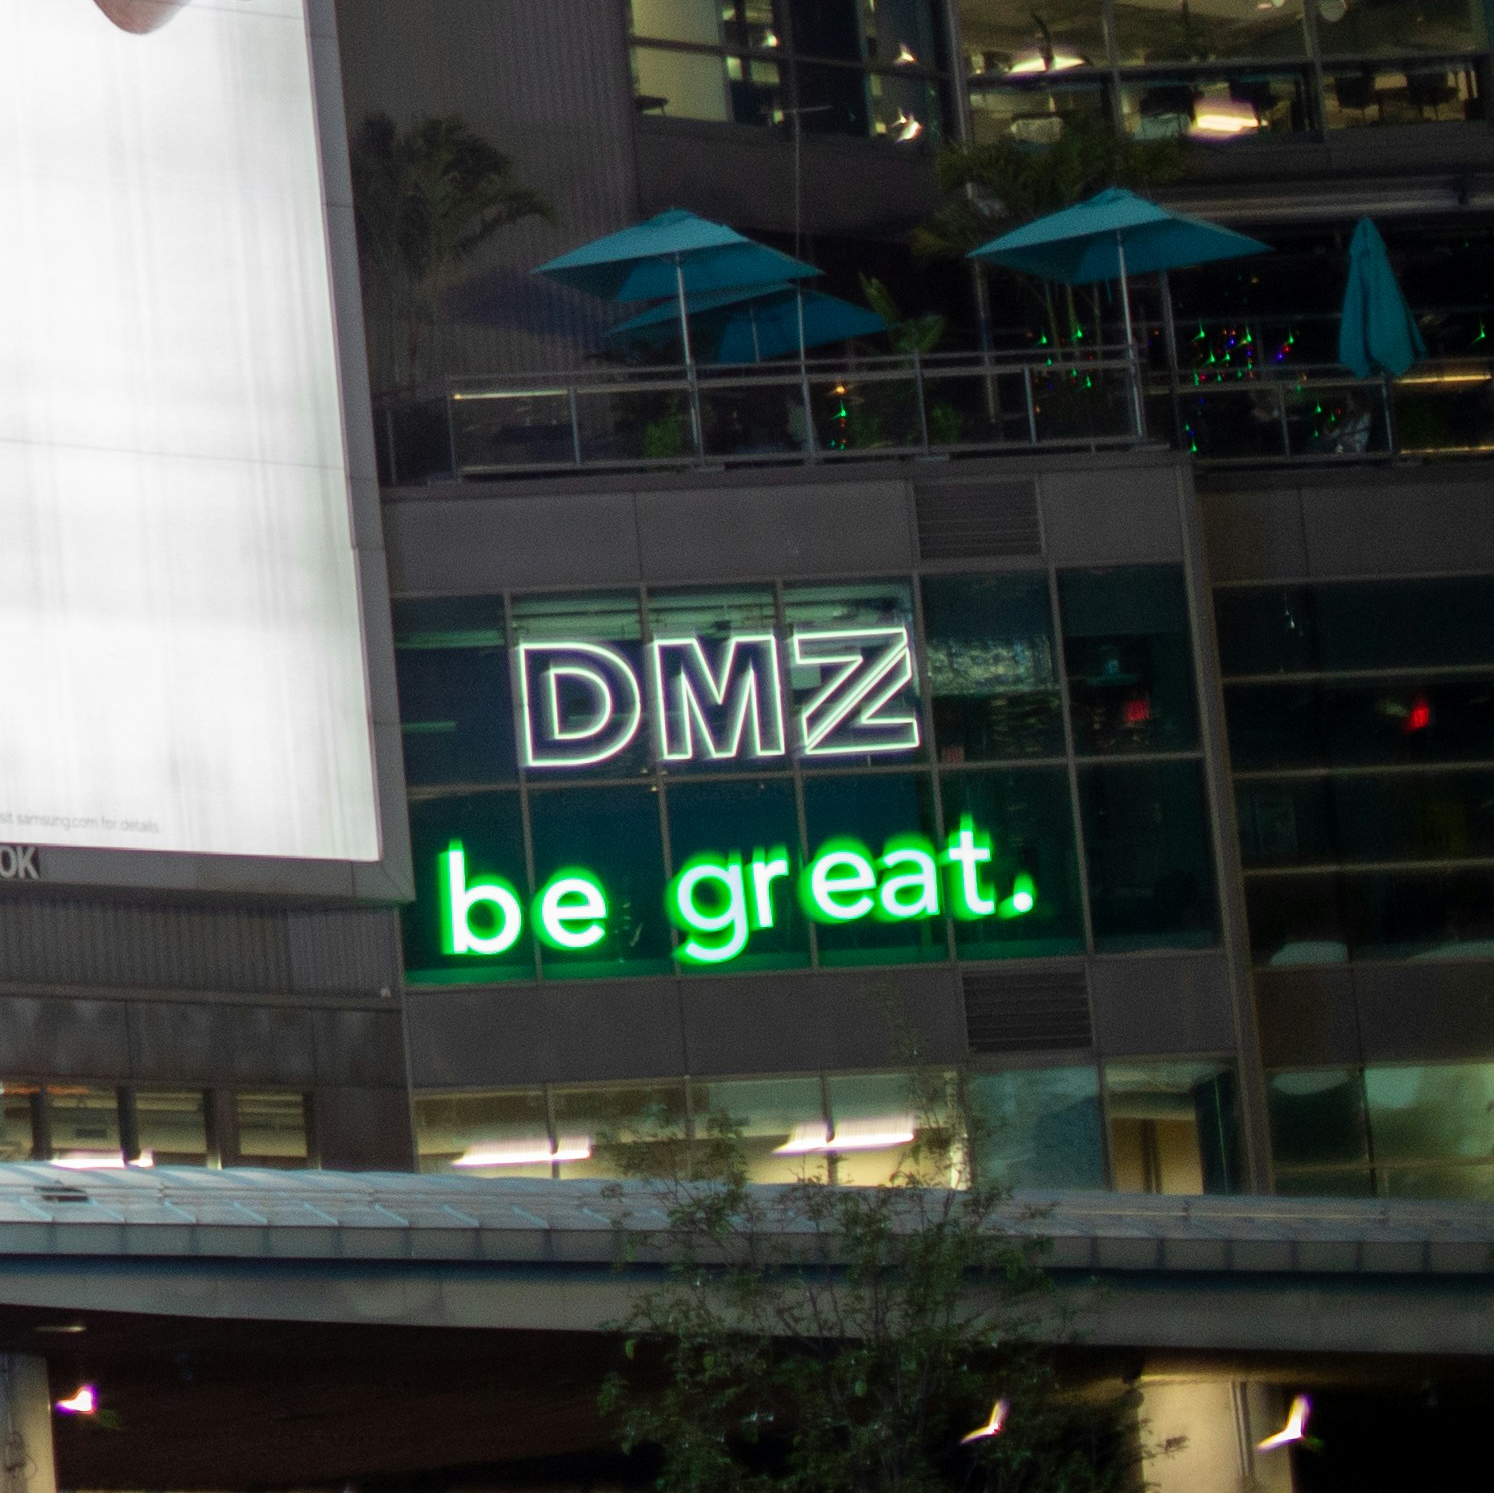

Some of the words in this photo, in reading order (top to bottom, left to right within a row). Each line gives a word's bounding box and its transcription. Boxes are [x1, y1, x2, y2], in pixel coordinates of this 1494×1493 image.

[519, 626, 920, 769] DMZ
[442, 841, 607, 956] be
[668, 816, 1036, 964] great.
